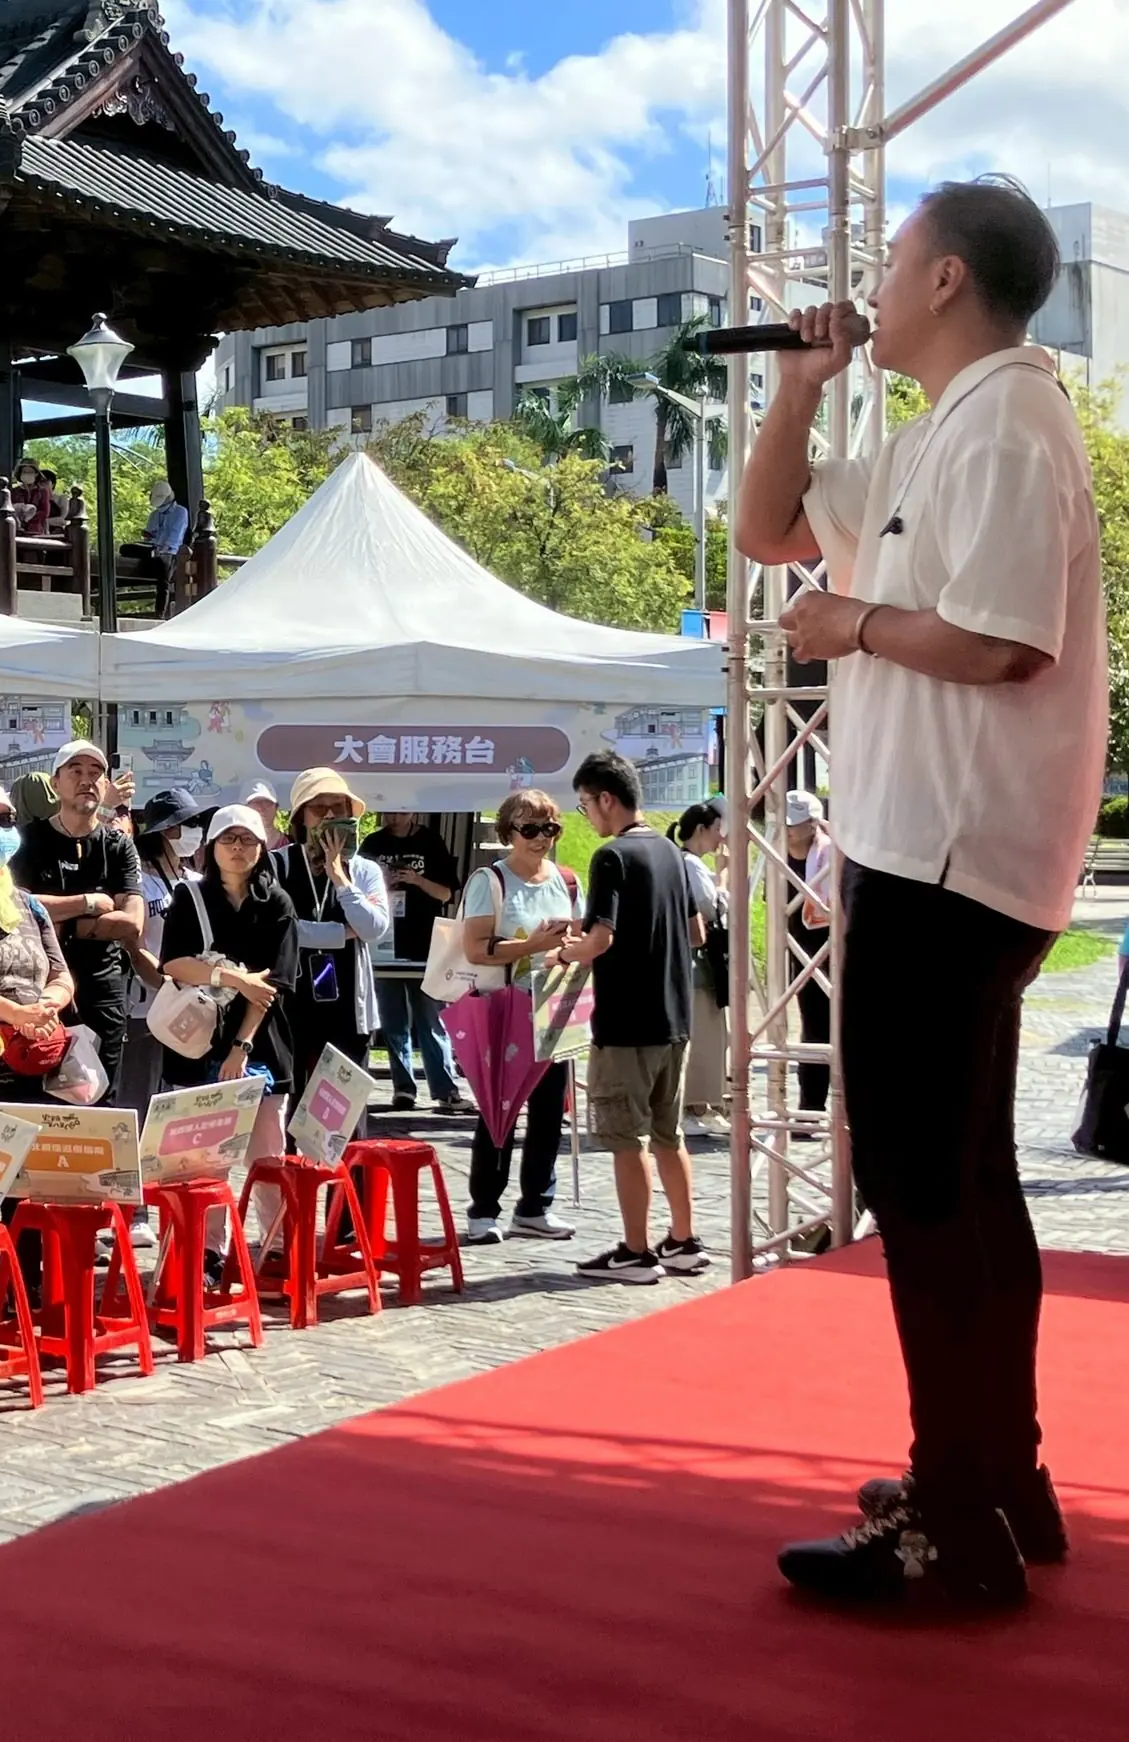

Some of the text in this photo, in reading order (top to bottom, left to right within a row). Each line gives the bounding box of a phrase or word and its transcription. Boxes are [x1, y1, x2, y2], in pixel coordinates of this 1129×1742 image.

[333, 734, 496, 765] 大會服務台
[57, 1155, 70, 1169] A
